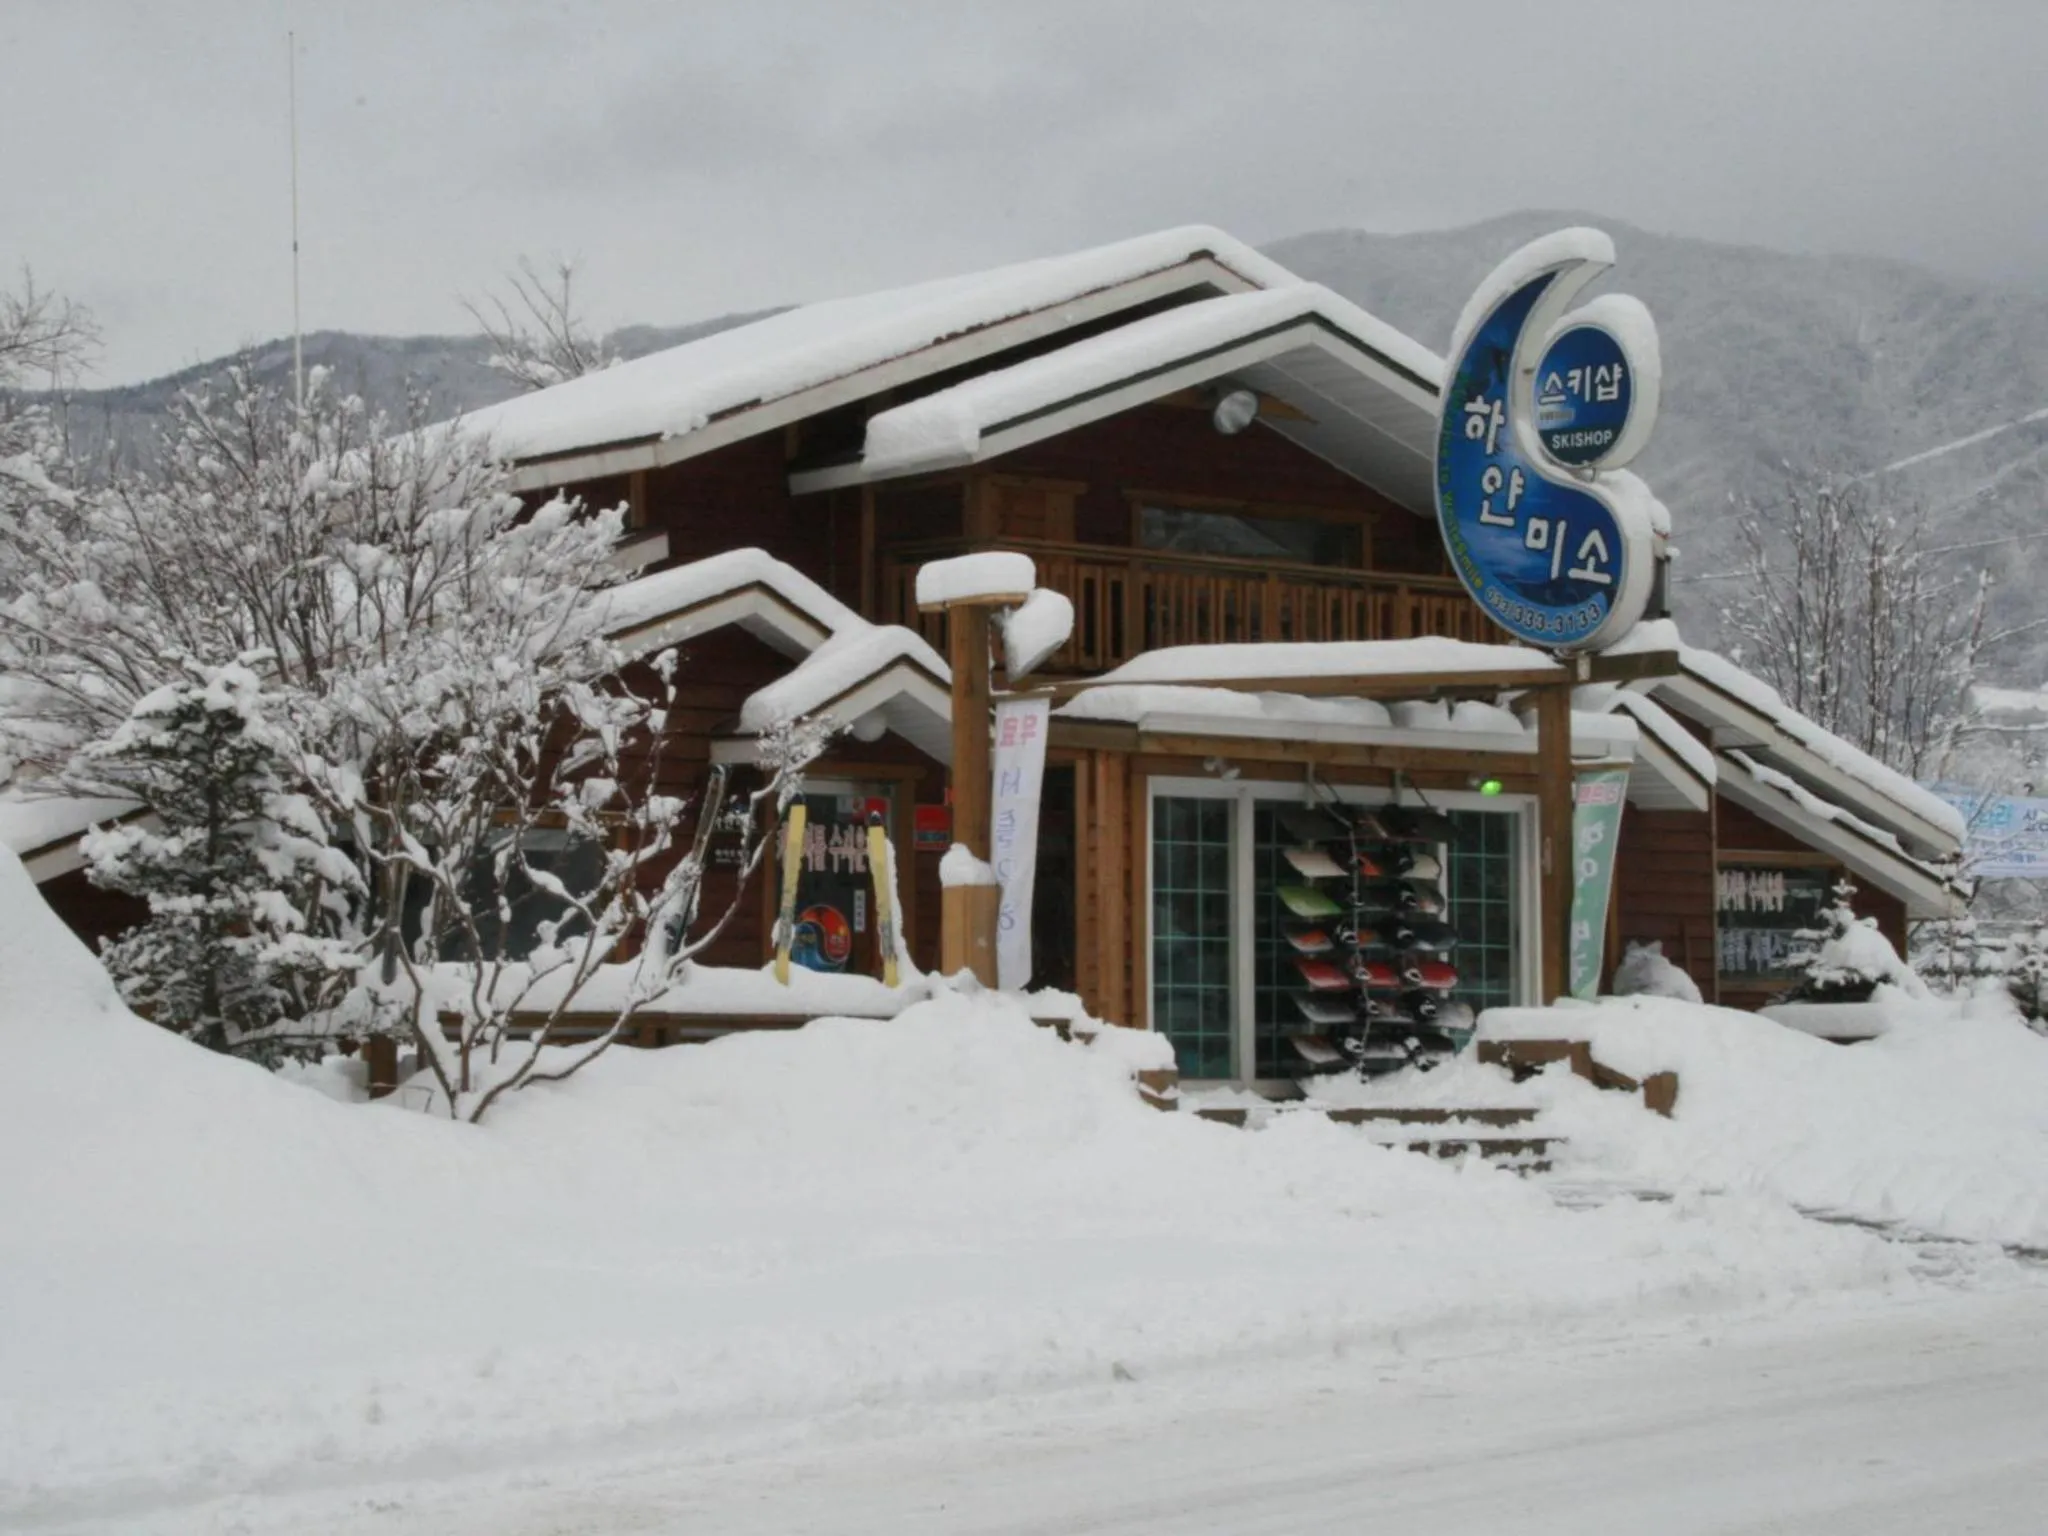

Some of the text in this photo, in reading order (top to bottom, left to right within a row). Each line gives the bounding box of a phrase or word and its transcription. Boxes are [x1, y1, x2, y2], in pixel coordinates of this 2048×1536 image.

[1538, 361, 1624, 406] 스키샵
[1551, 429, 1614, 450] SKISHOP
[1464, 394, 1613, 586] 하얀미소
